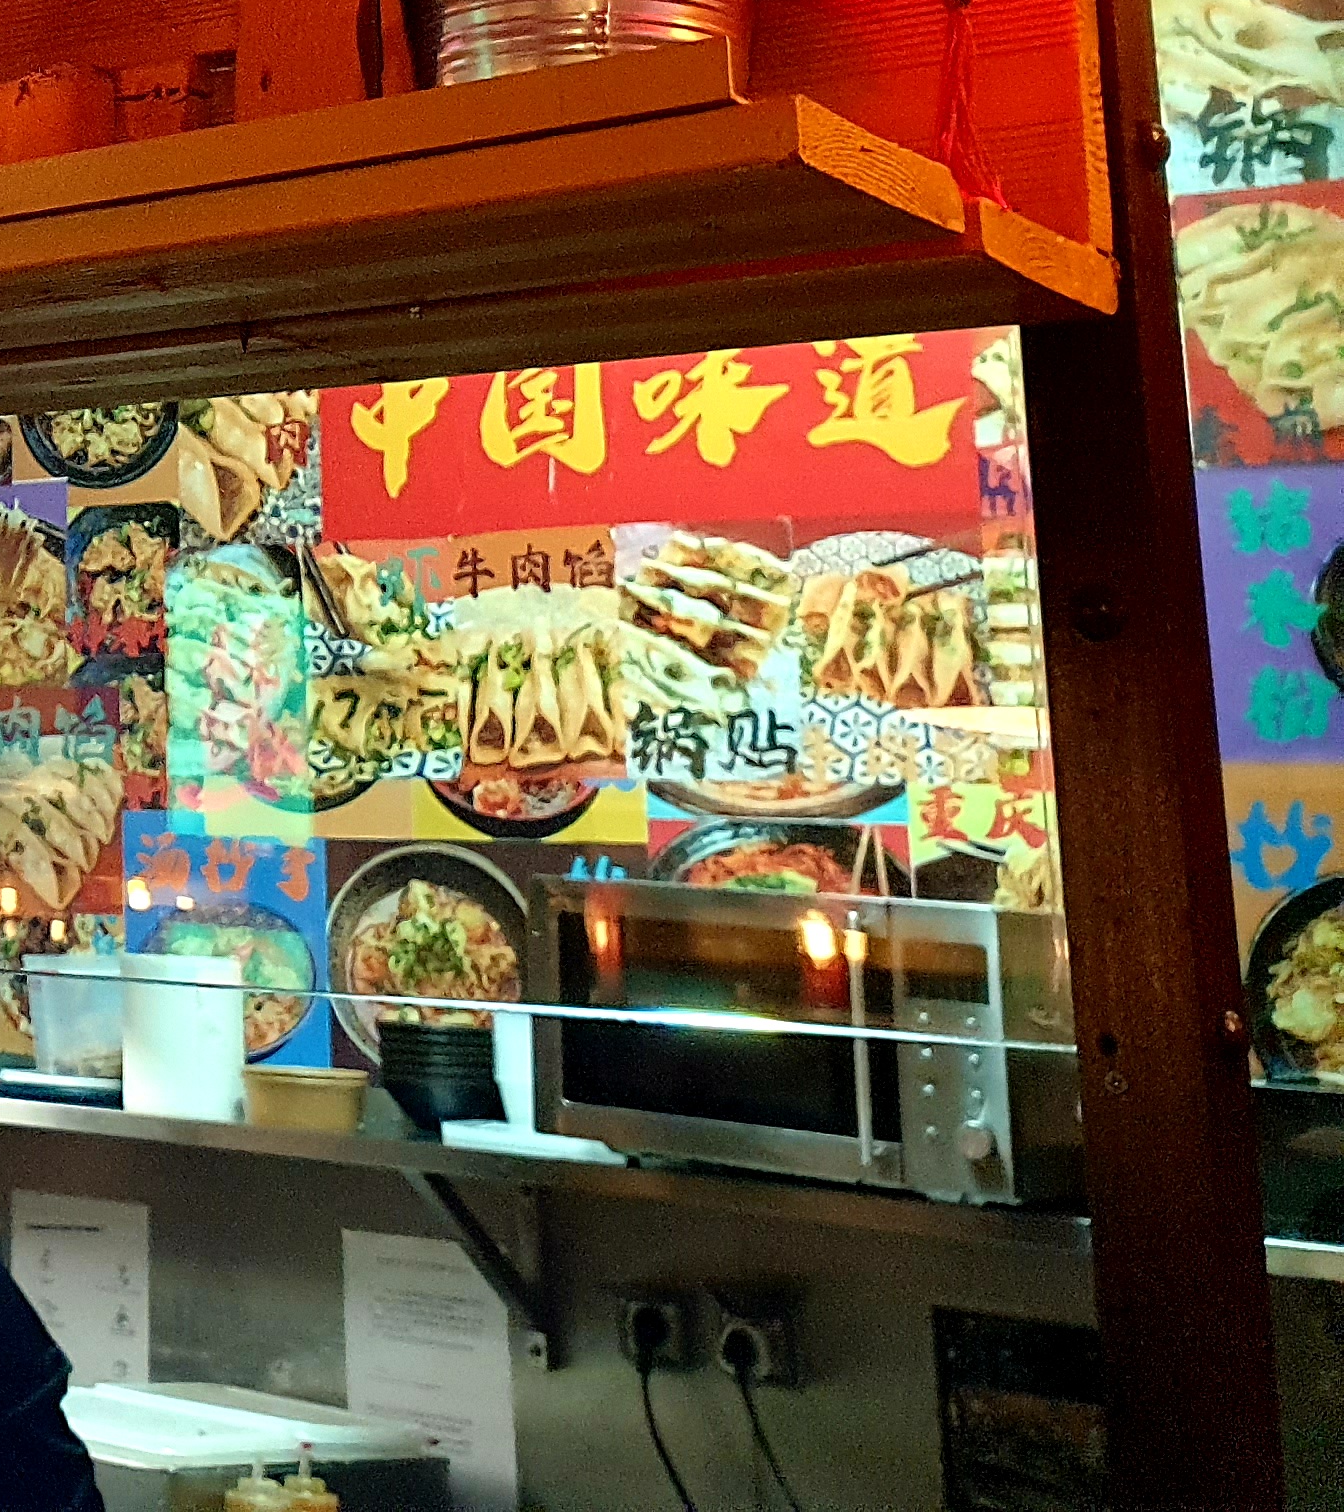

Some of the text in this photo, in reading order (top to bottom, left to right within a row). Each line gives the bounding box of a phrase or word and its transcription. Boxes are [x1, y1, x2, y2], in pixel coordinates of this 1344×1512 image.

[350, 333, 968, 498] 中国味道
[453, 539, 616, 599] 牛肉馅
[628, 700, 798, 779] 锅贴
